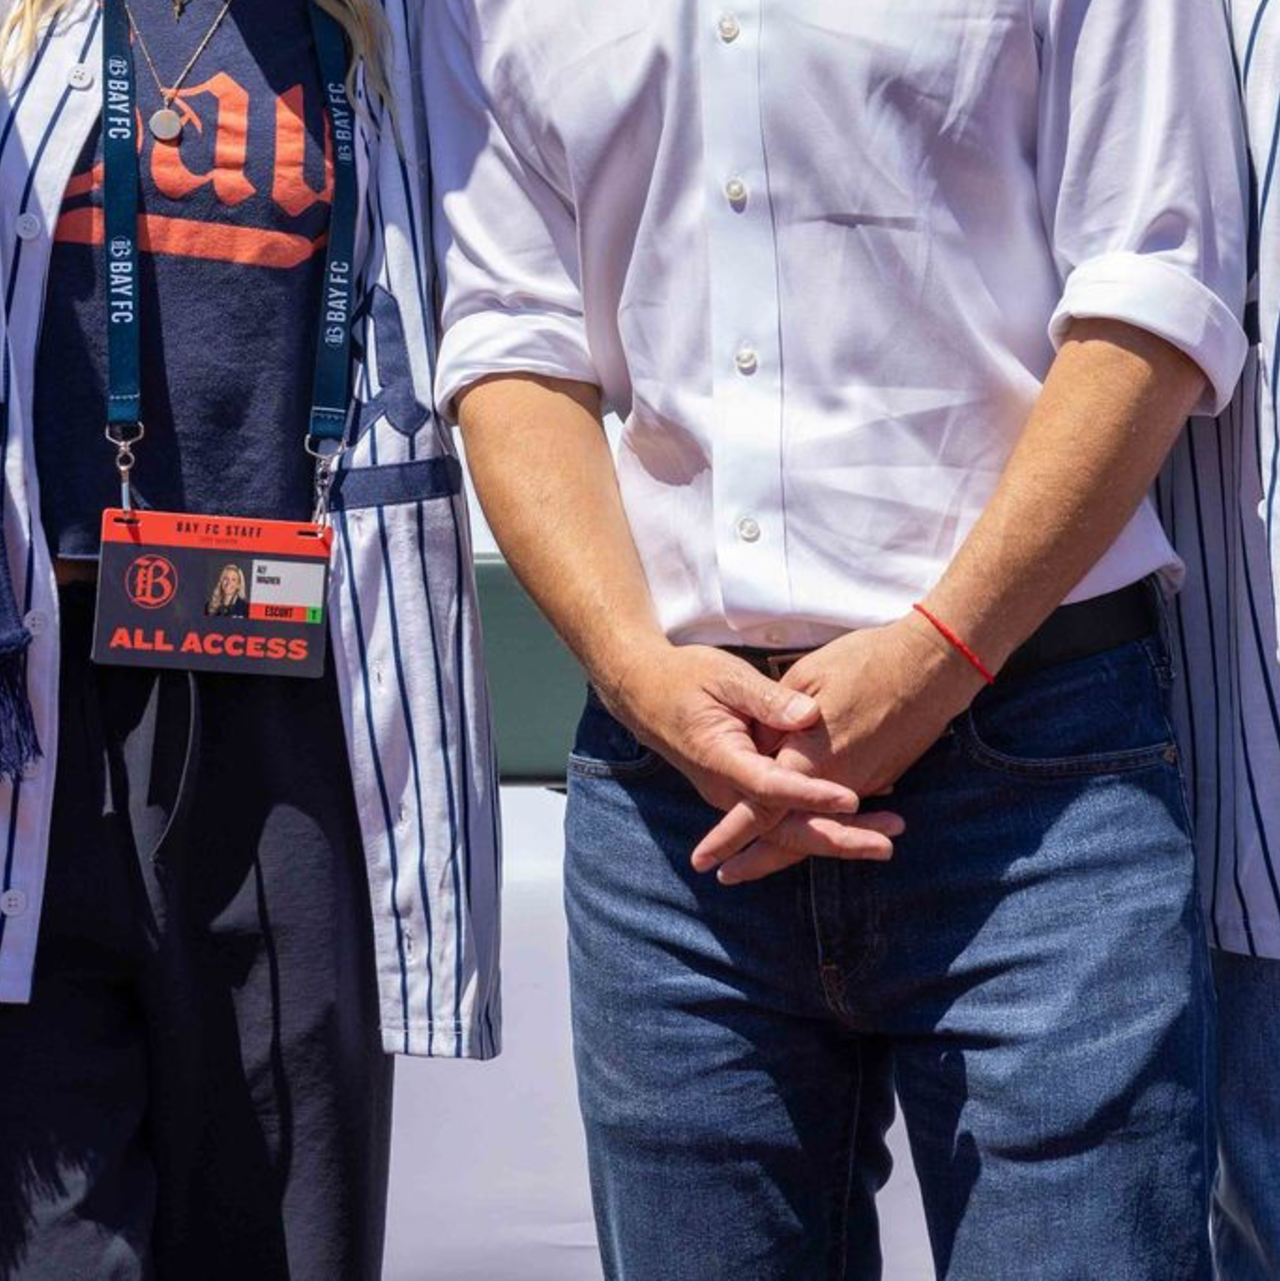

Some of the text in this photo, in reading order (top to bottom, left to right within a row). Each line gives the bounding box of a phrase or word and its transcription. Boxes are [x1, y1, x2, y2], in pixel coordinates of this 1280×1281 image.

[107, 78, 129, 112] BAY
[328, 82, 346, 106] FC
[108, 116, 131, 140] FC
[332, 108, 352, 145] BAY
[110, 262, 133, 295] BAY
[329, 260, 349, 285] FC
[111, 299, 133, 323] FC
[326, 286, 347, 322] BAY
[176, 522, 263, 538] BAY FC STAFF
[109, 627, 309, 661] ALL ACCESS
